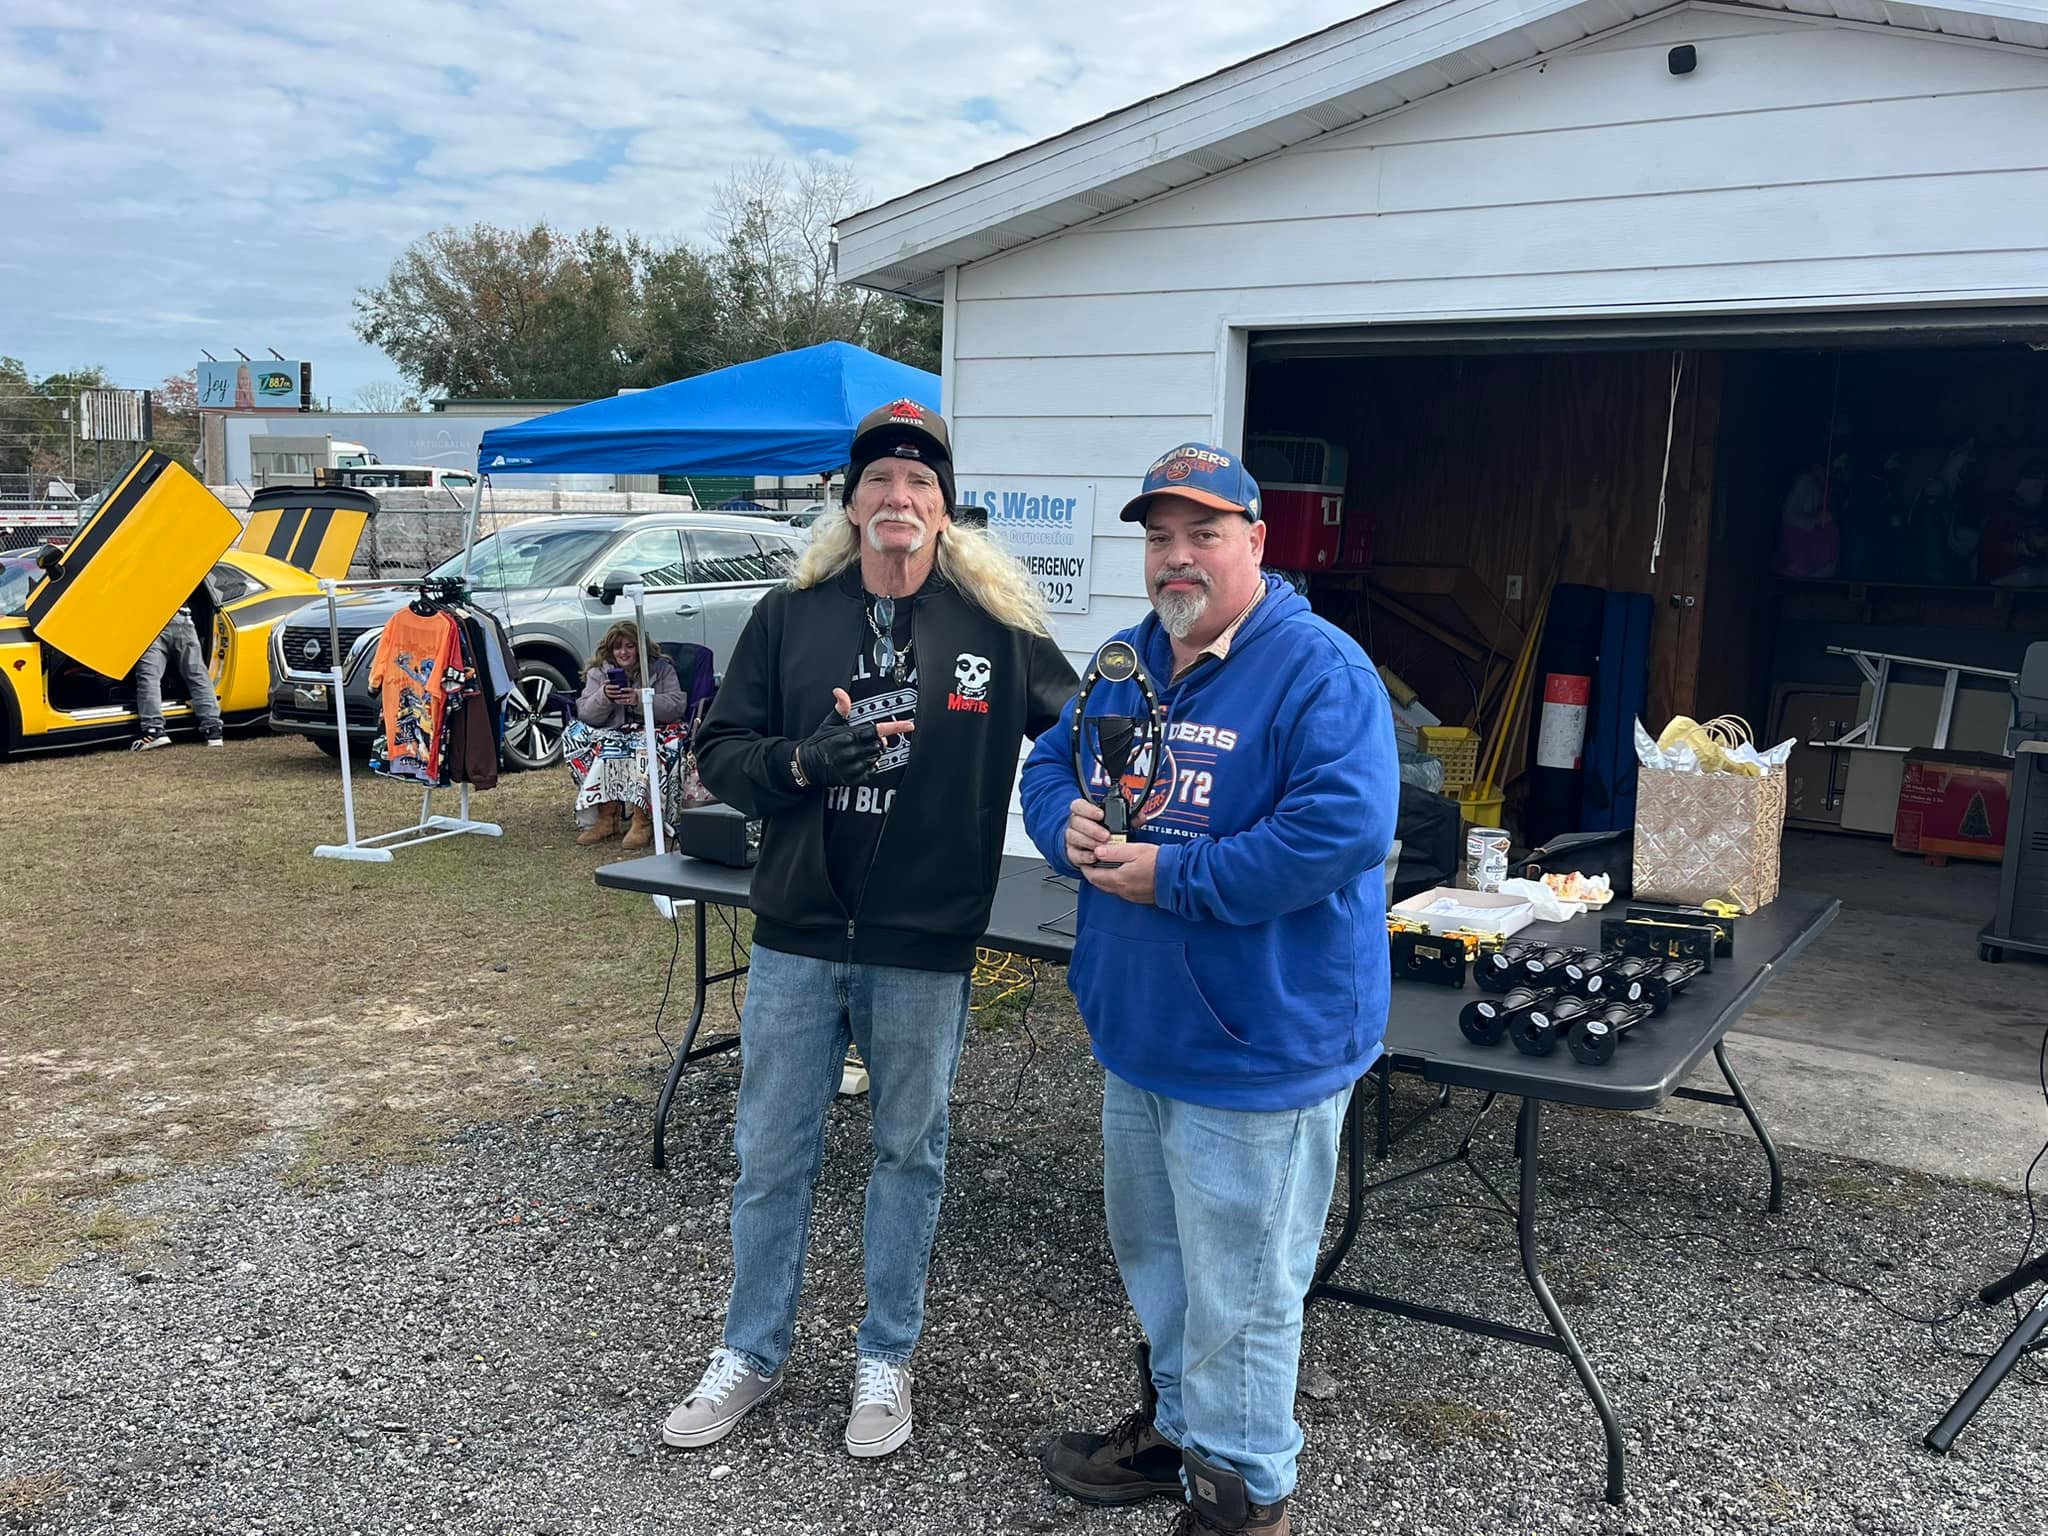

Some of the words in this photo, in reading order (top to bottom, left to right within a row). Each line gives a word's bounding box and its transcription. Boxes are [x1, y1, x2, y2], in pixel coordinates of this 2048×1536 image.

[203, 371, 229, 403] Joy
[1009, 530, 1073, 546] Corporation
[1015, 556, 1085, 577] MERGENCY
[1178, 768, 1213, 807] 72
